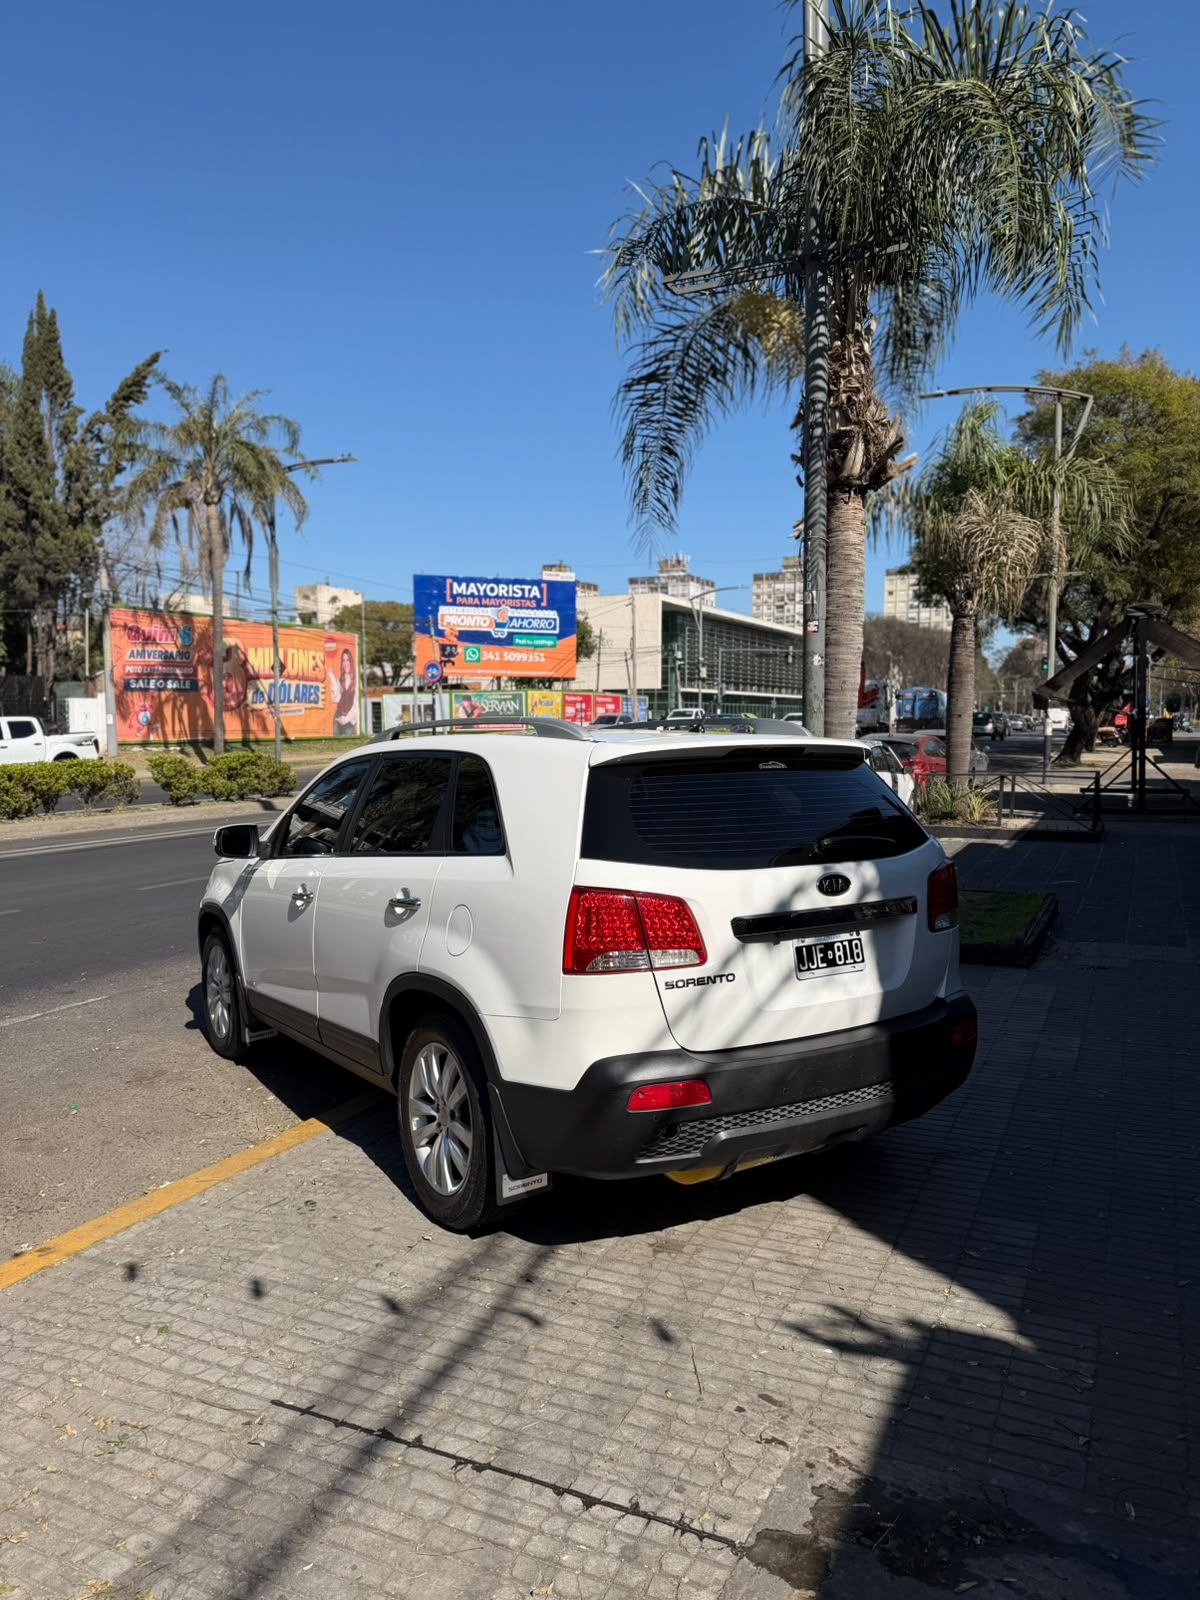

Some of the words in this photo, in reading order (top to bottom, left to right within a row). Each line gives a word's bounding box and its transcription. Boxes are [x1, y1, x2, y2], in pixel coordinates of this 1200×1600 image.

[452, 582, 541, 599] MAYORISTA
[456, 596, 480, 606] PARA
[481, 598, 537, 608] MAYORISTAS
[444, 615, 490, 627] PRONTO
[509, 618, 555, 629] AHORRO
[128, 649, 192, 660] ANIVERSARIO
[482, 651, 500, 662] 341
[129, 679, 156, 689] SALE
[166, 680, 191, 689] SALE
[665, 973, 736, 990] SORENTO
